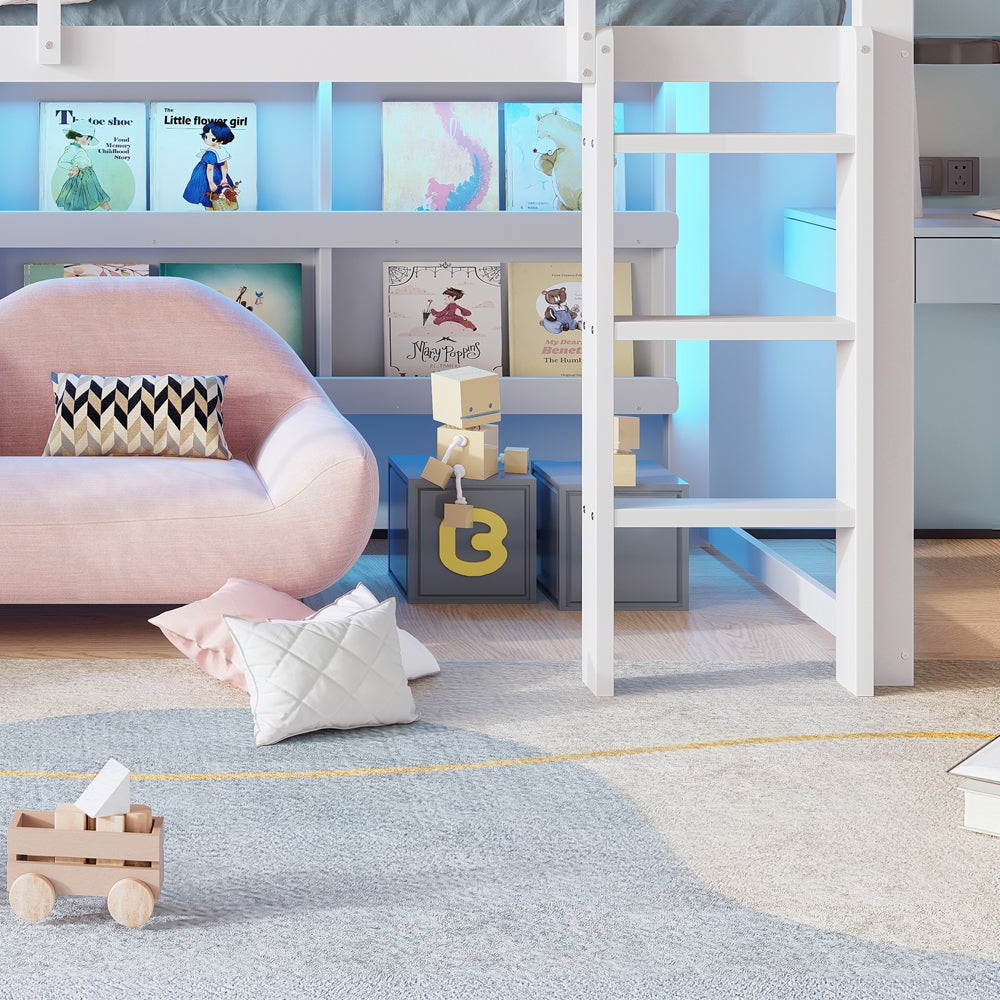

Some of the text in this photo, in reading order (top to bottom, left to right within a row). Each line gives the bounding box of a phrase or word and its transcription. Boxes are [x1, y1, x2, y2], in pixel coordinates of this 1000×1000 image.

[107, 117, 133, 126] shoe
[164, 115, 248, 128] Little flower girl
[105, 142, 131, 151] Memory
[407, 341, 481, 364] Mary Poppins
